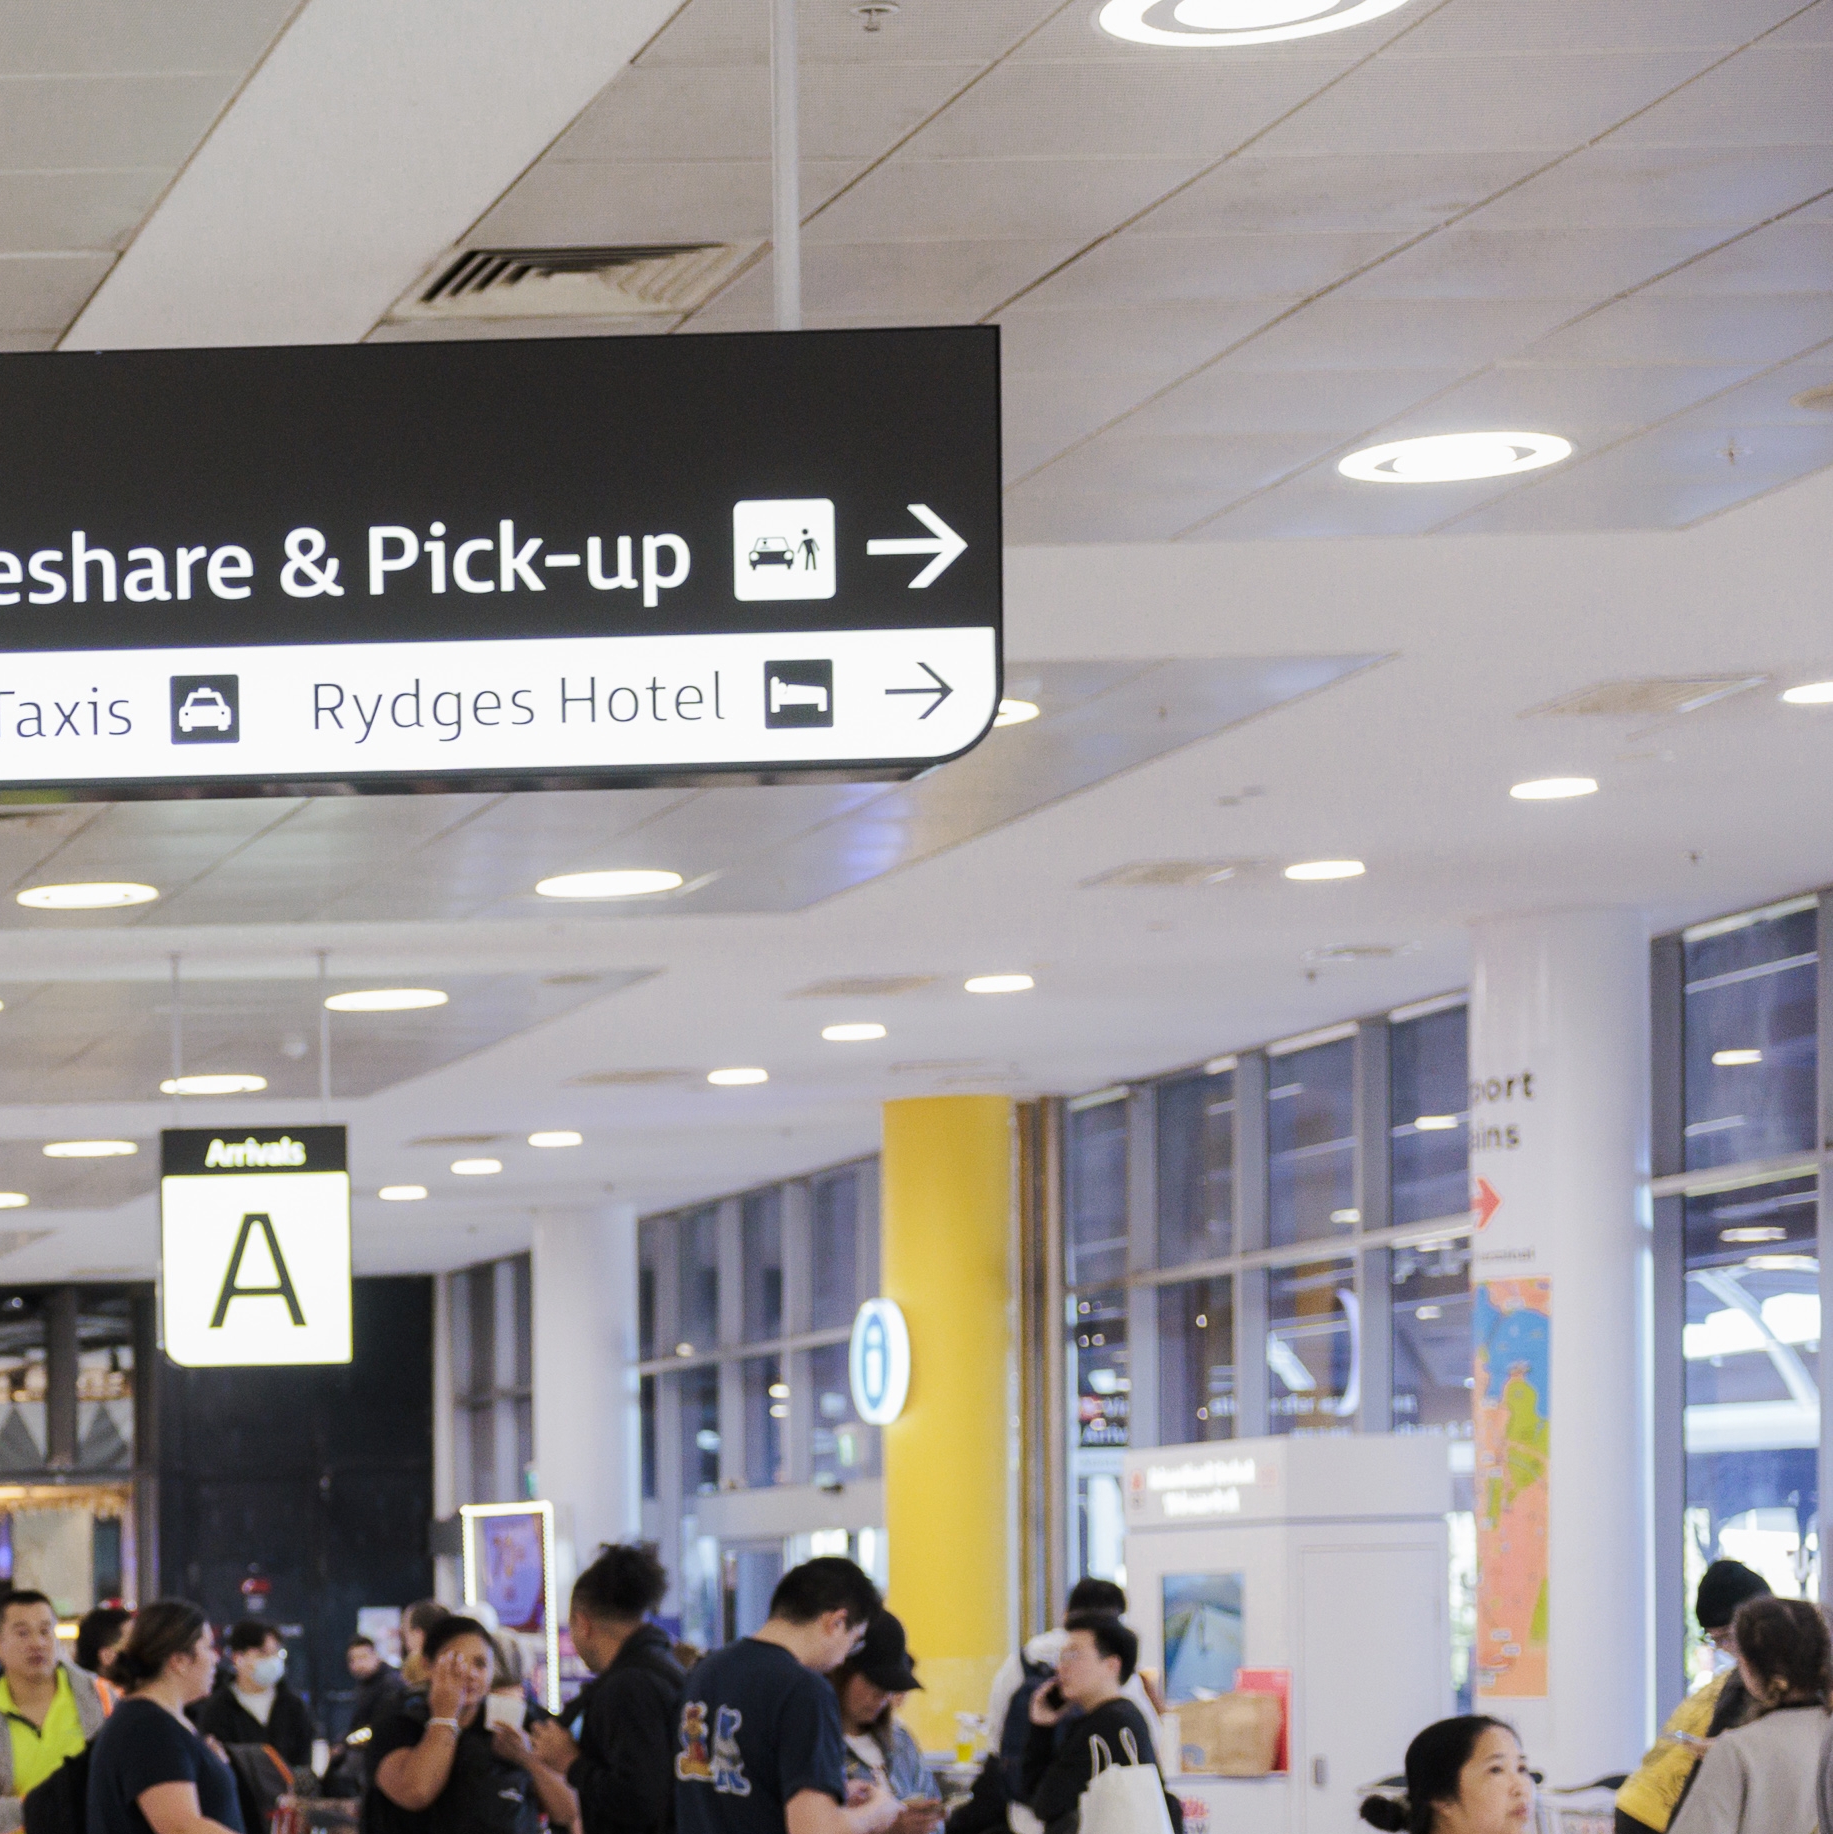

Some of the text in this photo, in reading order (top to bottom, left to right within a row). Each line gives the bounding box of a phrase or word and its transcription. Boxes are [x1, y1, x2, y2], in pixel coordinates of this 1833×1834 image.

[278, 526, 345, 599] &
[368, 519, 691, 609] Pick-up
[312, 671, 727, 745] Rydges Hotel
[204, 1136, 307, 1169] Arrivals
[208, 1212, 308, 1329] A
